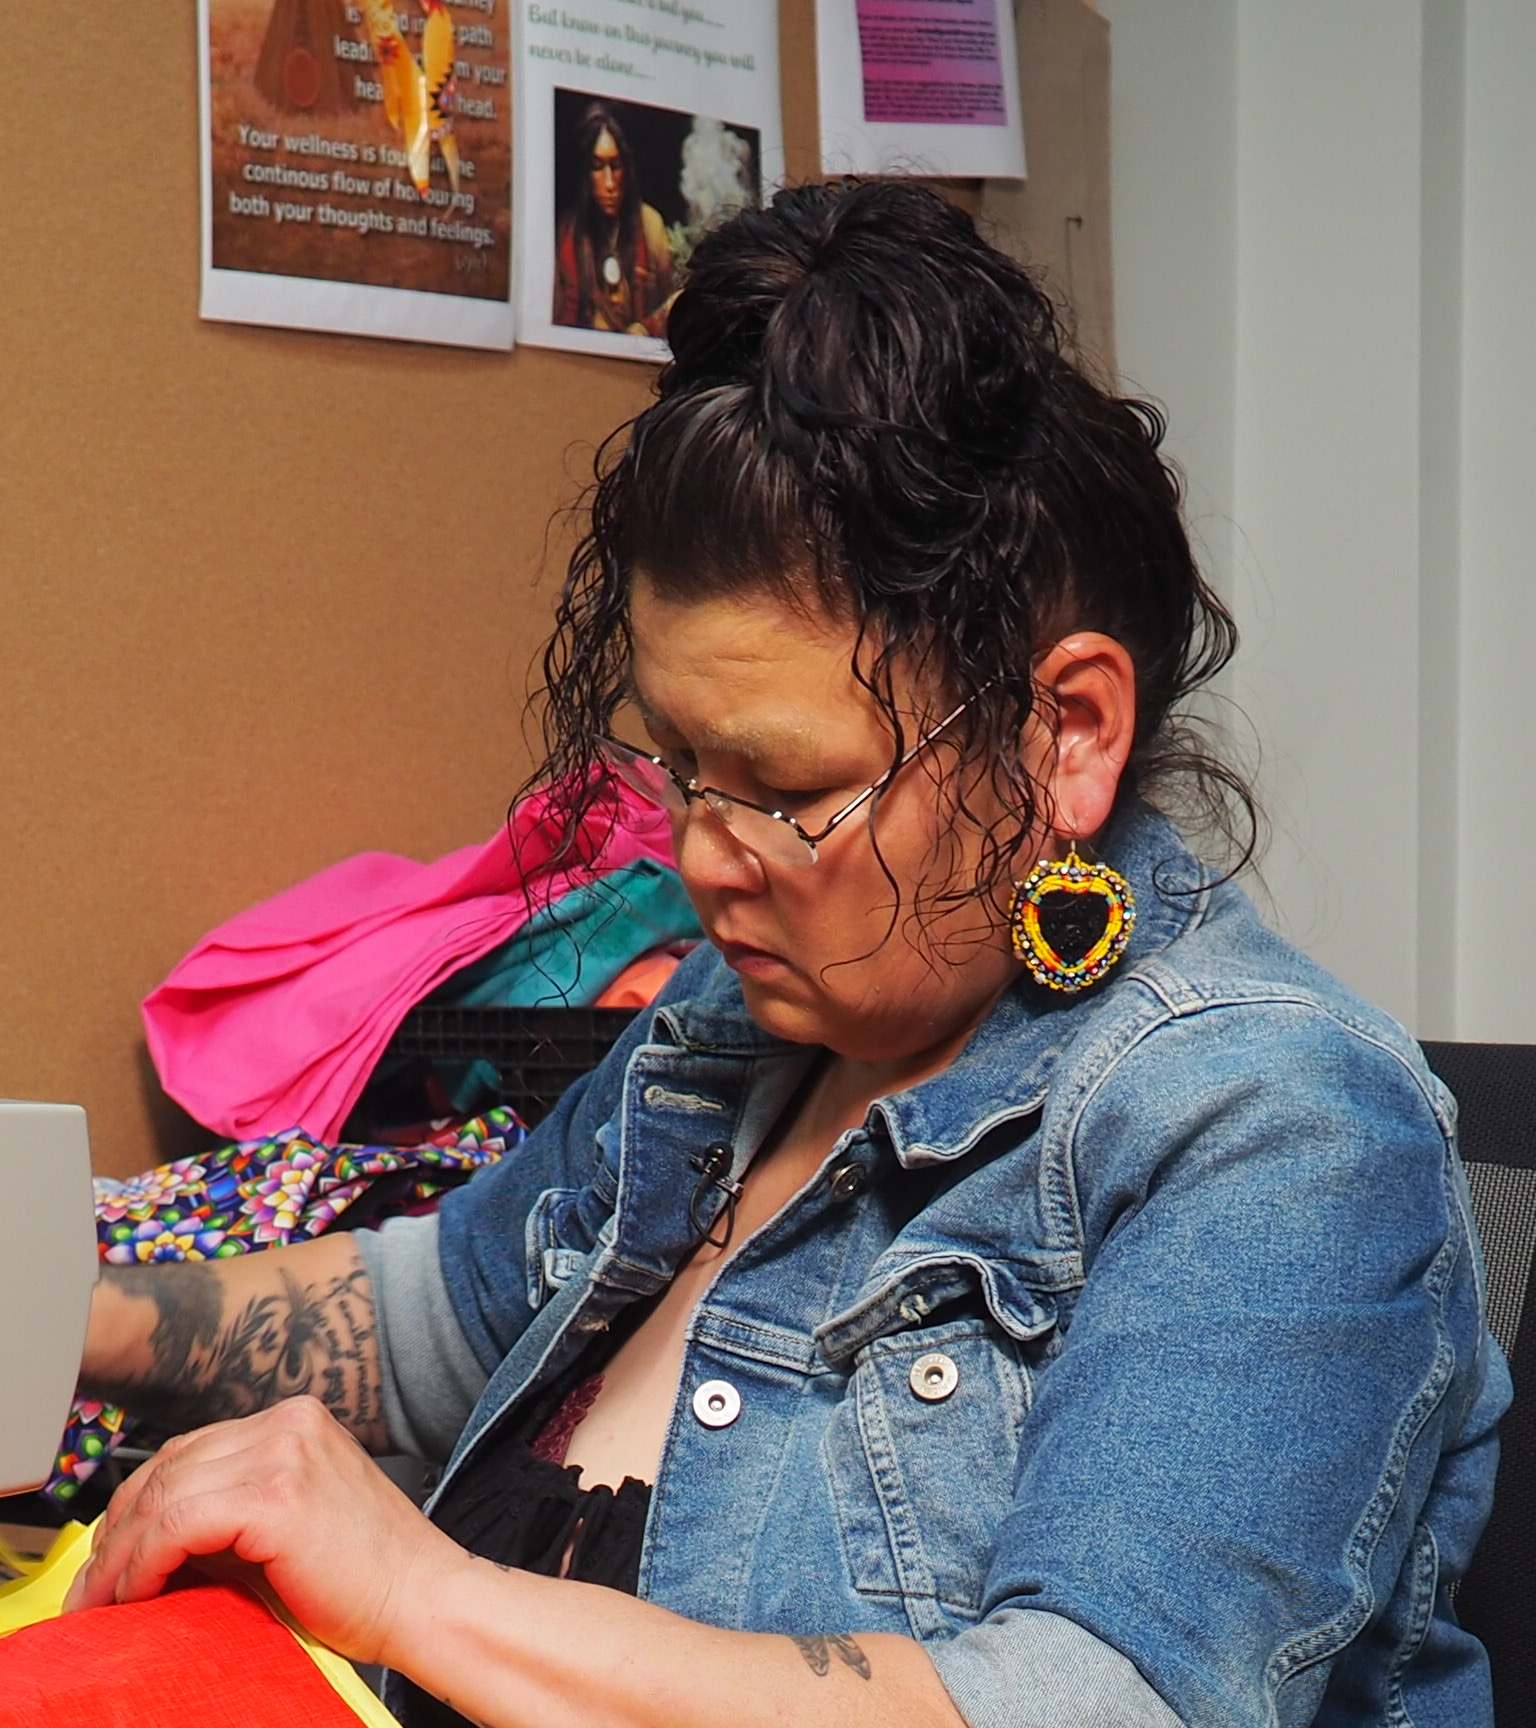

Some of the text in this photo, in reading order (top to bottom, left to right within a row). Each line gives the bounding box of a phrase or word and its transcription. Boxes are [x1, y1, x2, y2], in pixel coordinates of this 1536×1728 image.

[458, 24, 493, 47] path
[702, 48, 728, 68] you
[730, 52, 756, 72] will
[473, 64, 506, 85] your
[354, 75, 385, 102] hea
[238, 124, 279, 150] Your
[284, 132, 358, 161] wellness
[364, 141, 377, 162] is
[379, 144, 410, 167] fou
[243, 163, 329, 189] continous
[332, 169, 370, 195] flow
[373, 177, 392, 198] of
[229, 192, 495, 249] both your thoughts and feelings.
